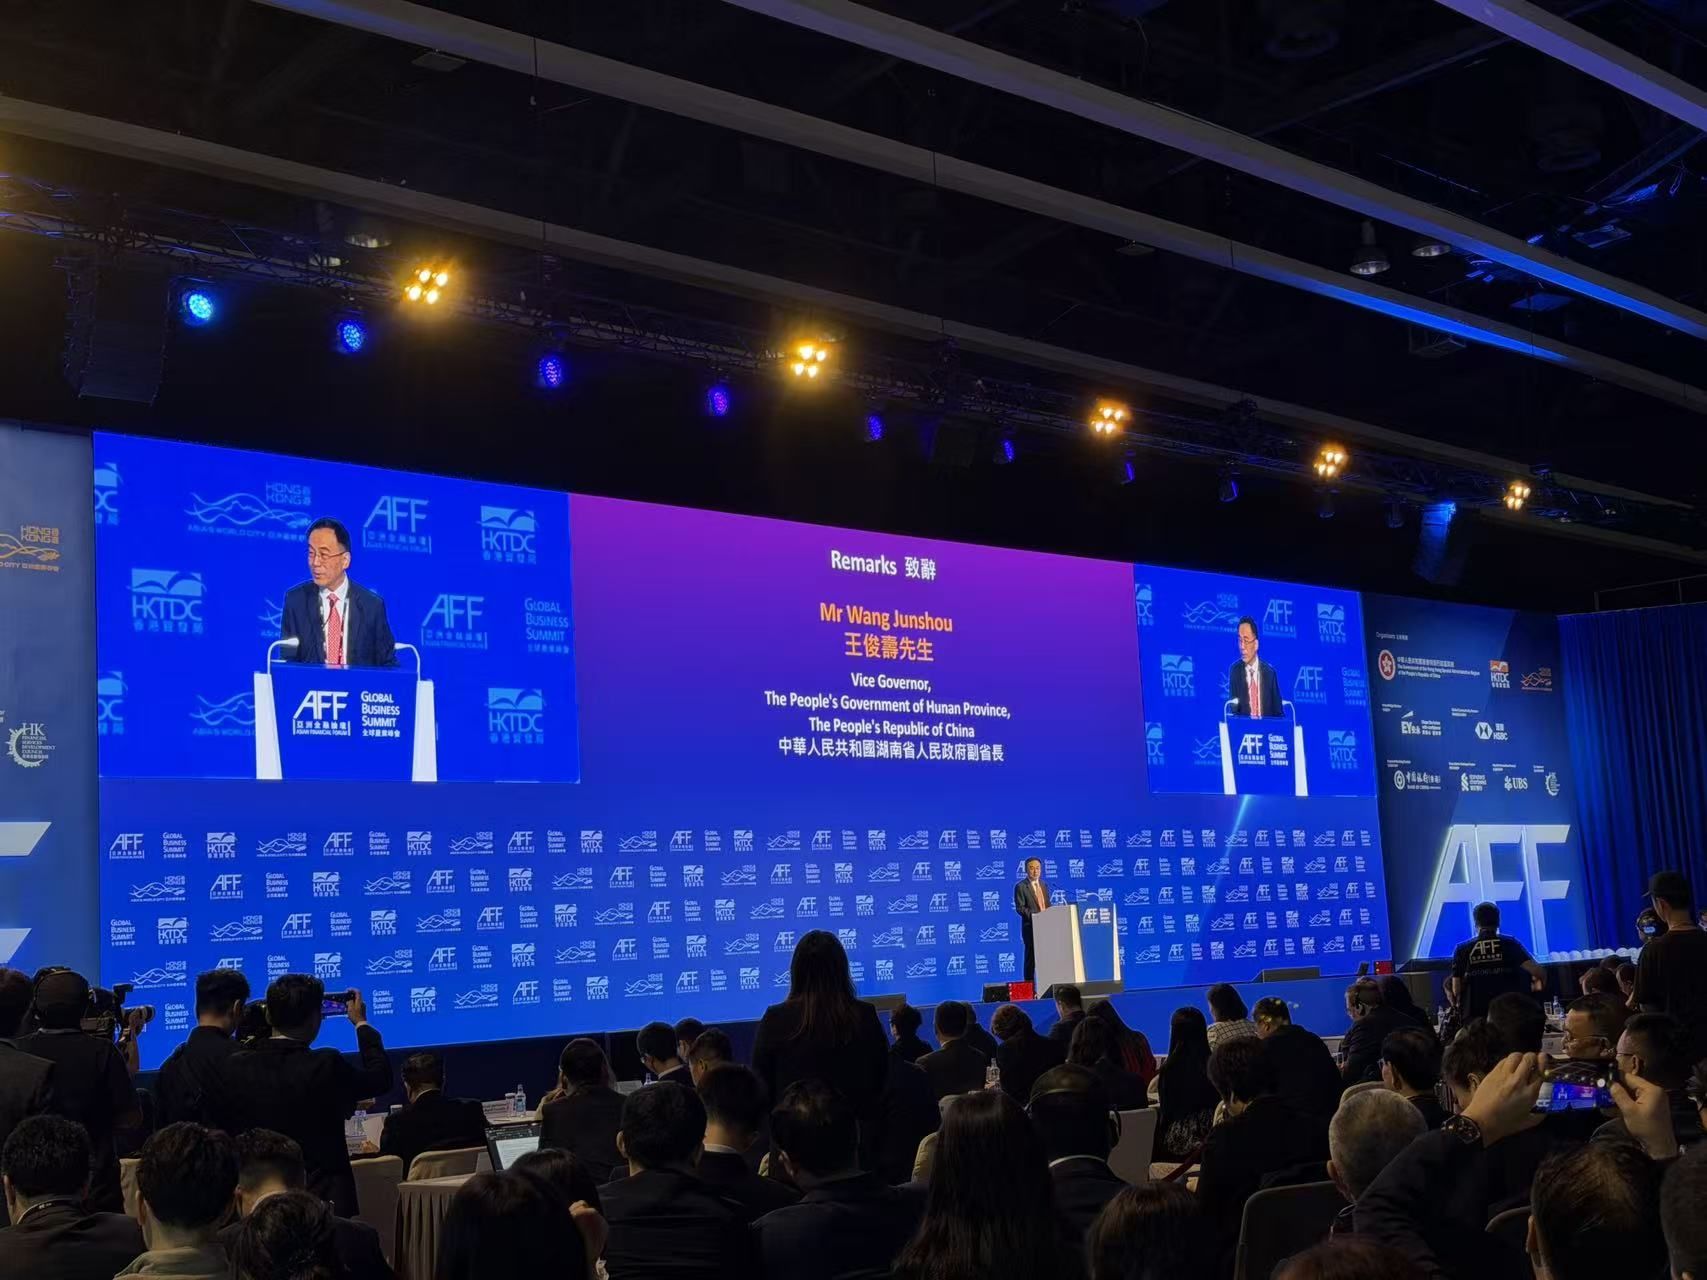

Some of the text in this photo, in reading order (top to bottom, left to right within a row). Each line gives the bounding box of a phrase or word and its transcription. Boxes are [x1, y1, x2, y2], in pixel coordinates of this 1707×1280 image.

[363, 495, 430, 532] AFF
[482, 530, 536, 553] HKTDC
[831, 550, 937, 581] Remarks 致辭
[132, 595, 203, 621] HKTDC
[422, 594, 484, 630] AFF
[525, 598, 561, 612] GLOBAL
[1263, 599, 1293, 625] AFF
[526, 613, 569, 628] BUSINESS
[820, 602, 953, 632] Mr Wang Junshou
[526, 627, 566, 641] SUMMIT
[1319, 620, 1345, 636] HKTDC
[844, 632, 934, 662] 王俊壽先生
[851, 672, 931, 693] Vice Governor,
[1162, 673, 1194, 689] HKTDC
[1294, 666, 1323, 690] AFF
[361, 690, 395, 703] GLOBAL
[293, 690, 349, 720] AFF
[362, 703, 401, 716] BUSINESS
[764, 690, 1011, 719] The People's Government of Hunan Province,
[22, 722, 45, 736] HK
[362, 715, 397, 728] SUMMIT
[489, 711, 544, 733] HKTDC
[808, 717, 975, 738] The People's Republic of China
[1401, 721, 1412, 734] EY
[779, 736, 1004, 762] 中華人民共和國湖南省人民政府副省長
[1238, 733, 1264, 755] AFF
[1329, 747, 1356, 762] HKTDC
[1512, 777, 1528, 790] UBS
[110, 834, 144, 850] AFF
[324, 832, 353, 848] AFF
[508, 831, 533, 846] AFF
[670, 830, 693, 845] AFF
[207, 844, 235, 853] HKTDC
[407, 842, 431, 851] HKTDC
[427, 870, 454, 885] AFF
[610, 866, 633, 881] AFF
[210, 874, 242, 890] AFF
[313, 883, 339, 892] HKTDC
[509, 879, 532, 887] HKTDC
[1412, 823, 1571, 962] AFF
[477, 907, 503, 922] AFF
[648, 902, 671, 916] AFF
[282, 913, 312, 930] AFF
[371, 921, 396, 930] HKTDC
[111, 933, 133, 941] SUMMIT
[158, 929, 187, 939] HKTDC
[613, 938, 636, 953] AFF
[1470, 939, 1501, 955] AFF
[430, 947, 456, 962] AFF
[512, 953, 535, 963] HKTDC
[215, 957, 243, 970] AFF
[315, 963, 341, 973] HKTDC
[513, 981, 539, 996] AFF
[411, 998, 435, 1007] HKTDC
